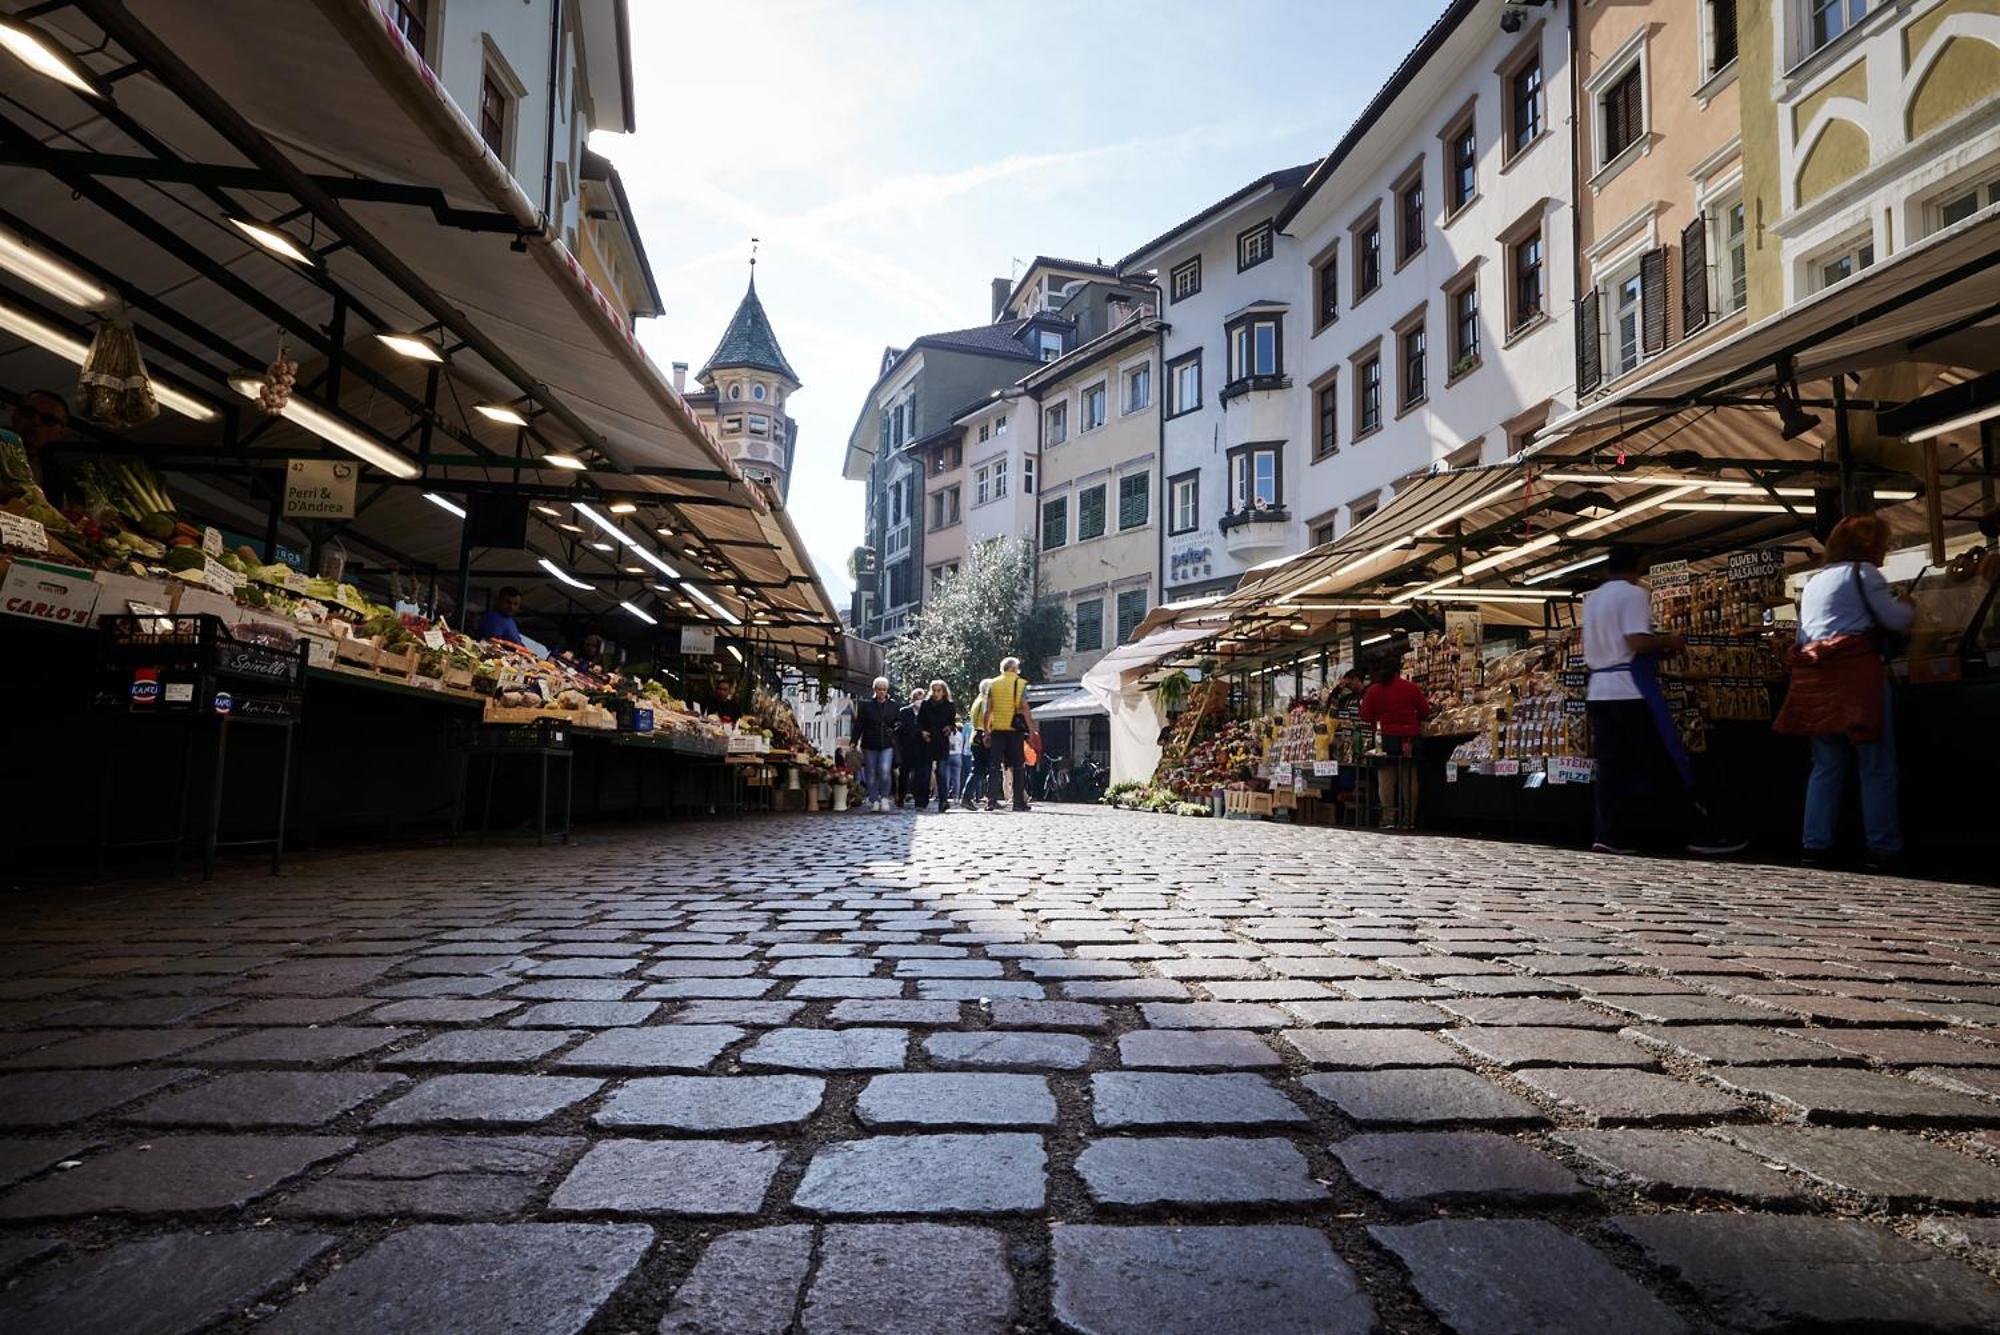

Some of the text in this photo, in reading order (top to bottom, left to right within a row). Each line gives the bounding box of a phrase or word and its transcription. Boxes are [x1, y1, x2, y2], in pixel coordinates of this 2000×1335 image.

[291, 462, 304, 473] 42
[289, 487, 333, 500] Perri &
[287, 500, 344, 514] D'Andrea
[1729, 553, 1758, 569] OLIVEN
[1761, 550, 1774, 563] ÖL
[1728, 566, 1775, 581] BALSAMICO
[1652, 574, 1688, 587] BALSAMICO
[7, 597, 88, 623] CARLO'S
[230, 654, 286, 676] Spinelli
[131, 685, 160, 696] KANZI
[1559, 757, 1591, 769] STEIN
[1559, 770, 1590, 783] PILZE
